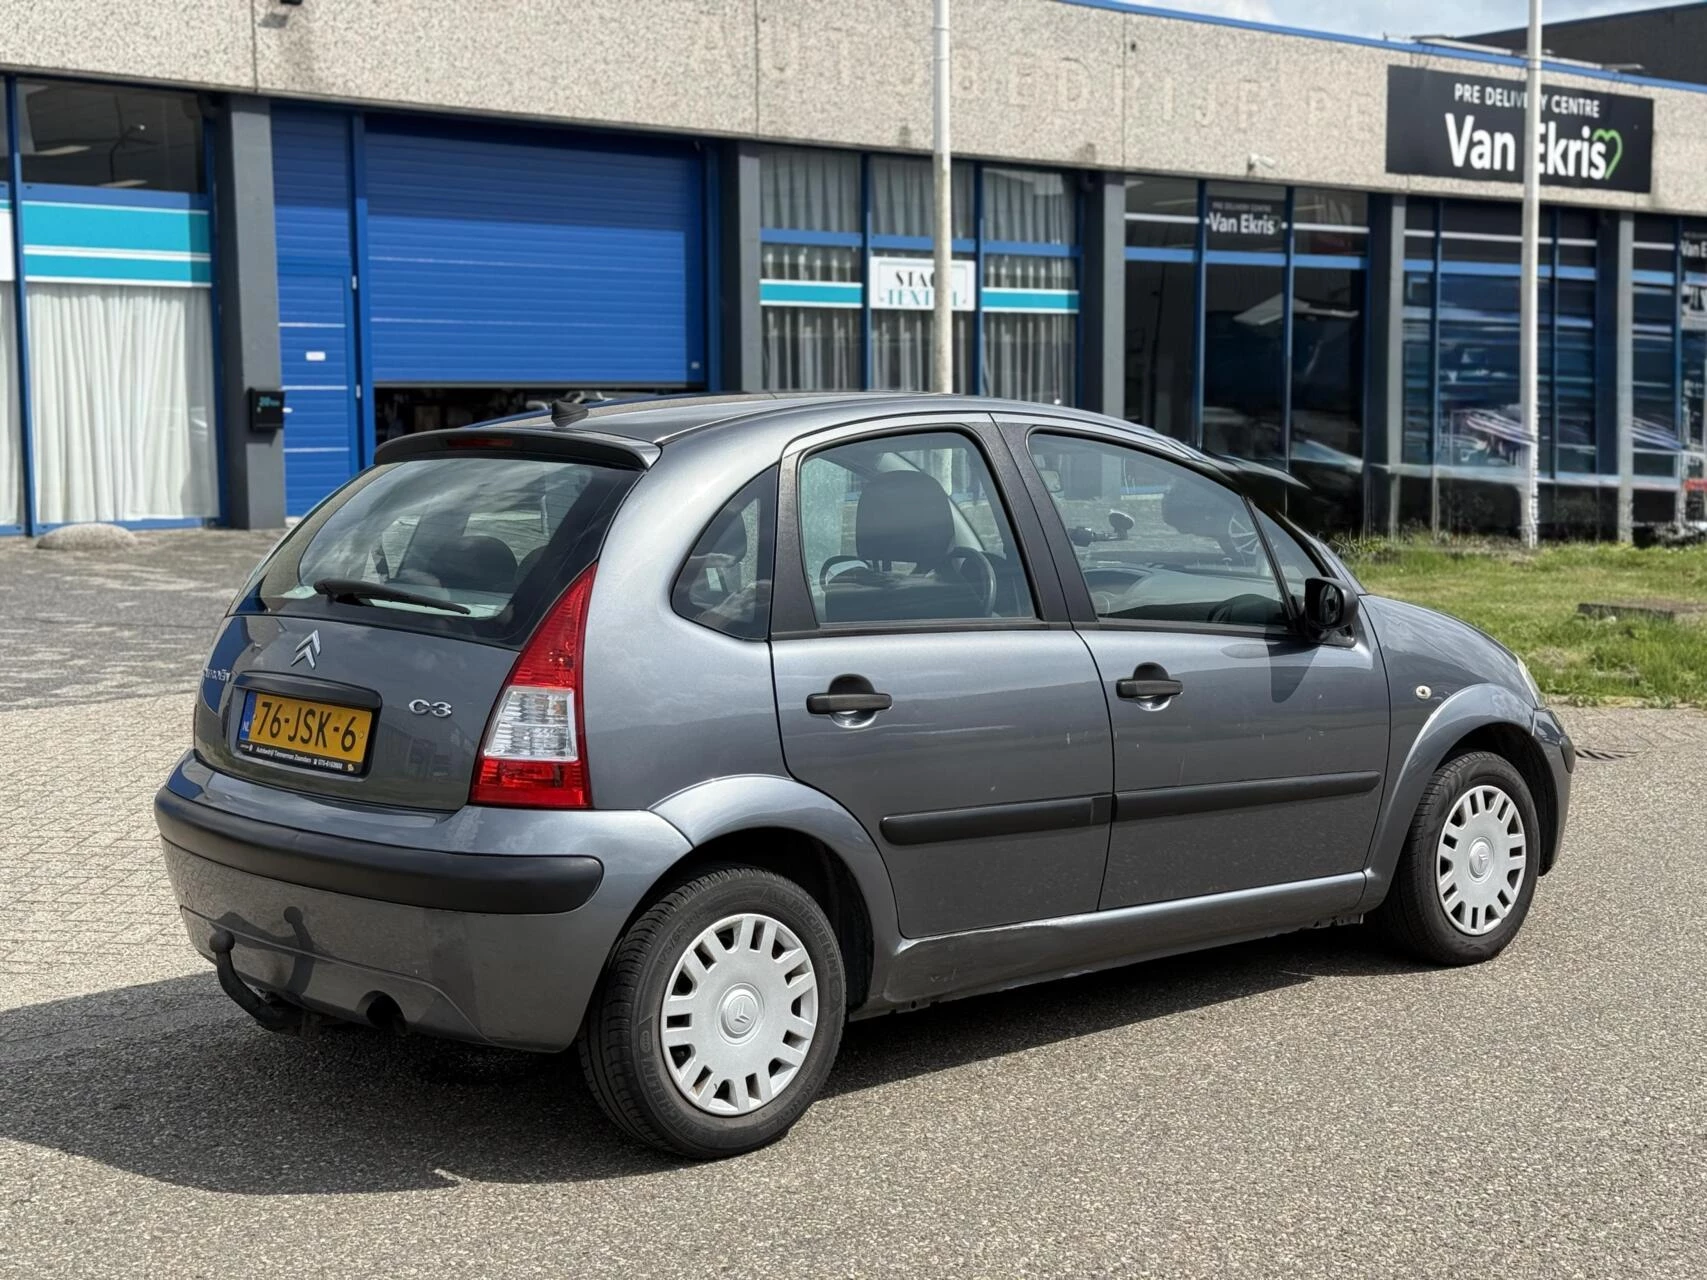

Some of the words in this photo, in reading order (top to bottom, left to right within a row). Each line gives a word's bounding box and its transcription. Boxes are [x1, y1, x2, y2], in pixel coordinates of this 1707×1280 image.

[1454, 83, 1480, 104] PRE
[1485, 87, 1548, 111] DELIVY
[1552, 95, 1600, 118] CENTRE
[1445, 113, 1516, 172] Van
[1209, 212, 1238, 232] Van
[1240, 213, 1275, 235] Ekris
[408, 698, 452, 718] C3
[257, 701, 357, 753] 76-JSK-6
